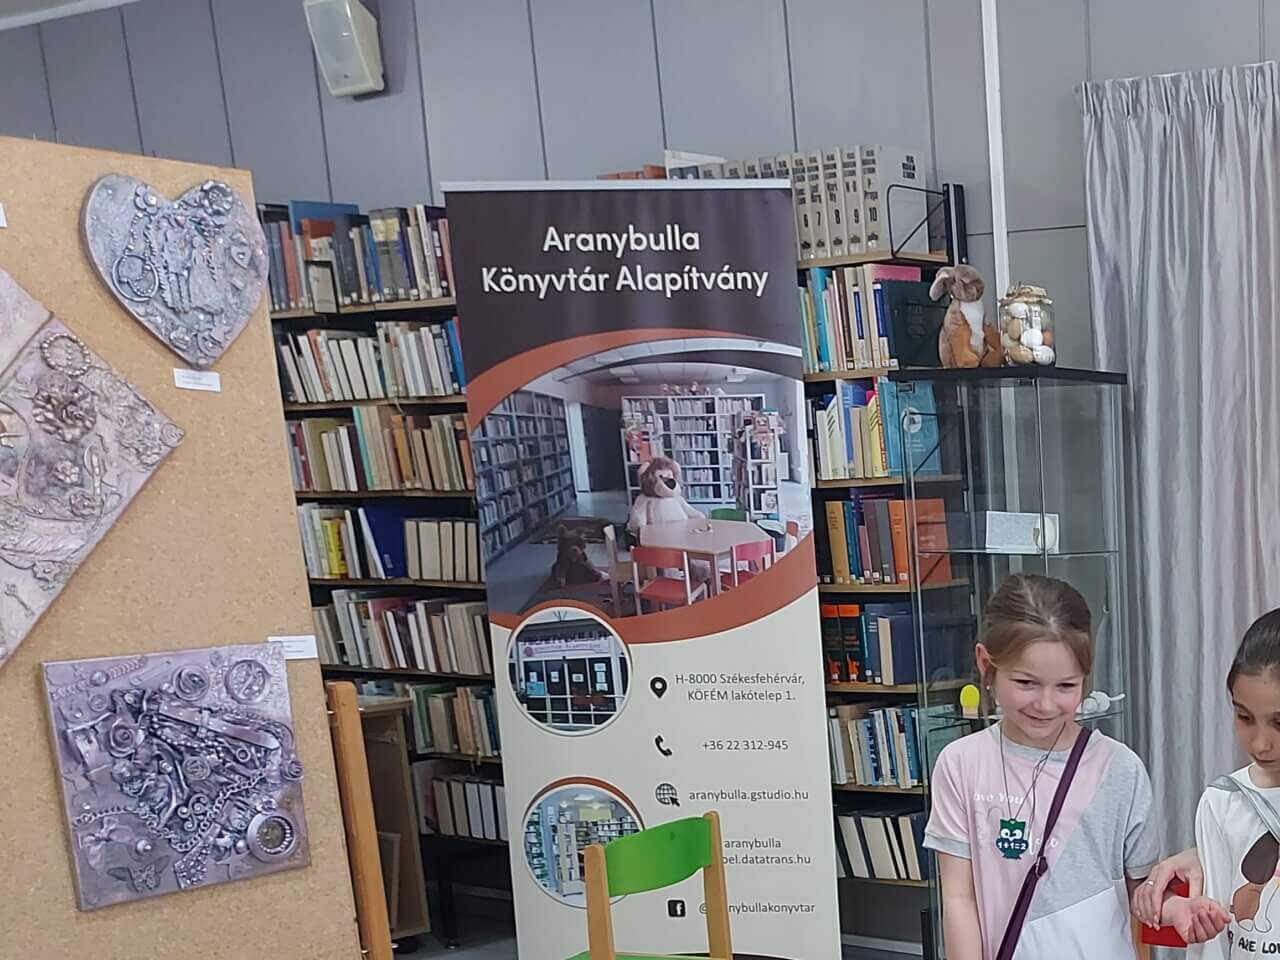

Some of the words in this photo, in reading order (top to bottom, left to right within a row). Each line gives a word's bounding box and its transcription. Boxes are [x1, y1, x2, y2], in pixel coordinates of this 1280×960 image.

[803, 214, 809, 227] 6
[816, 211, 822, 226] 7
[834, 209, 841, 224] 8
[853, 208, 860, 223] 9
[868, 207, 878, 222] 10
[543, 224, 700, 258] Aranybulla
[482, 265, 609, 299] Könyvtár
[615, 264, 769, 298] Alapítvány
[675, 673, 718, 684] H-8000
[719, 672, 806, 685] Székesfehérvár,
[687, 688, 728, 701] KÖFÉM
[731, 689, 783, 702] lakótelep
[702, 739, 724, 751] +36
[726, 739, 740, 751] 22
[743, 739, 789, 751] 312-945
[689, 788, 809, 802] aranybulla.gstudio.hu
[724, 837, 782, 850] aranybulla
[997, 842, 1027, 850] 1+1=2
